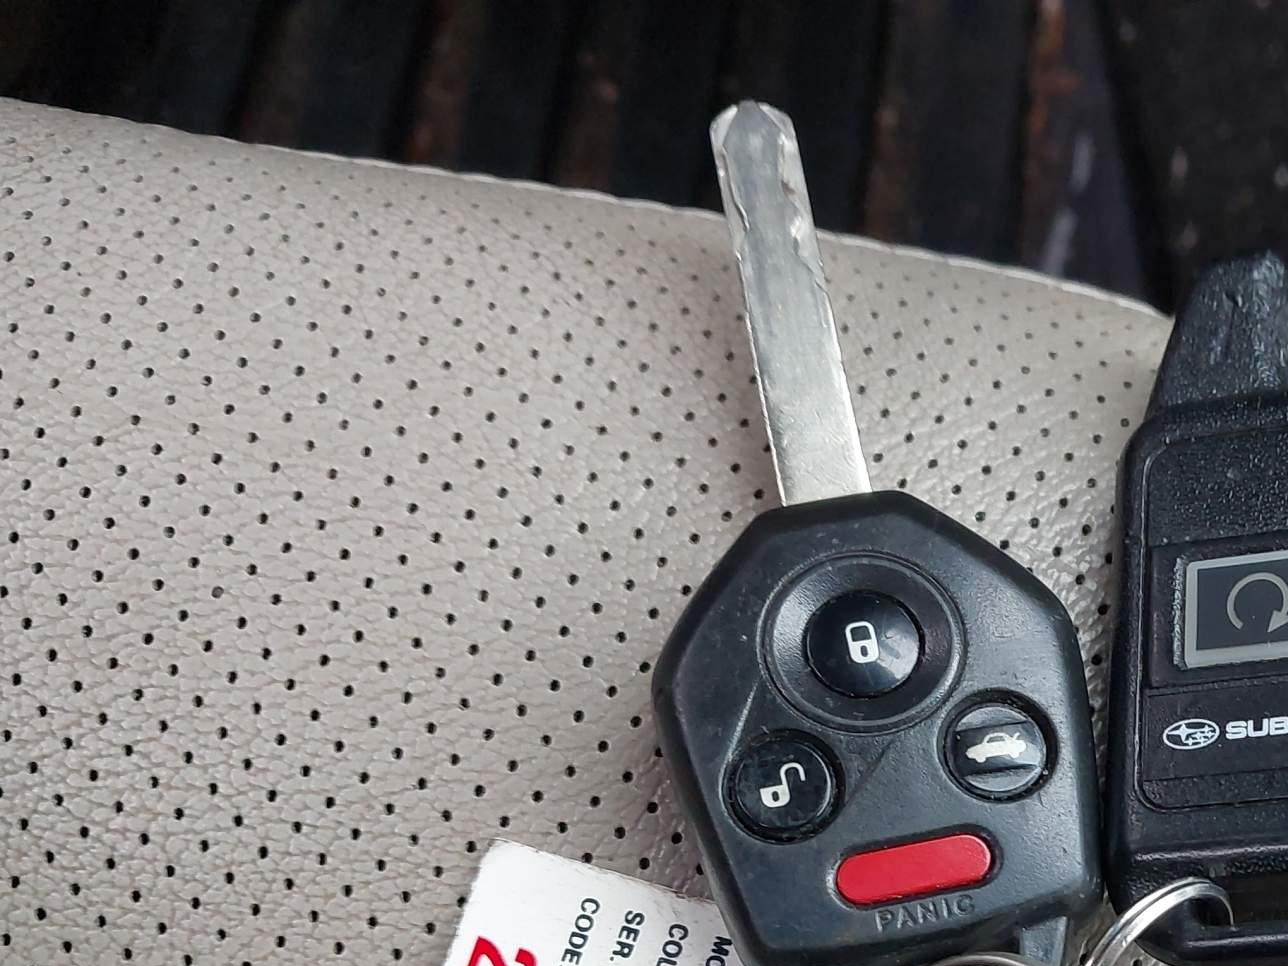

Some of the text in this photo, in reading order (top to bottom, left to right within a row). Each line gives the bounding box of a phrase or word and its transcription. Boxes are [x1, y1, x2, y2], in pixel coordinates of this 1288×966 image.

[561, 897, 600, 966] CODE
[609, 910, 645, 962] SER.
[873, 894, 976, 932] PANIC
